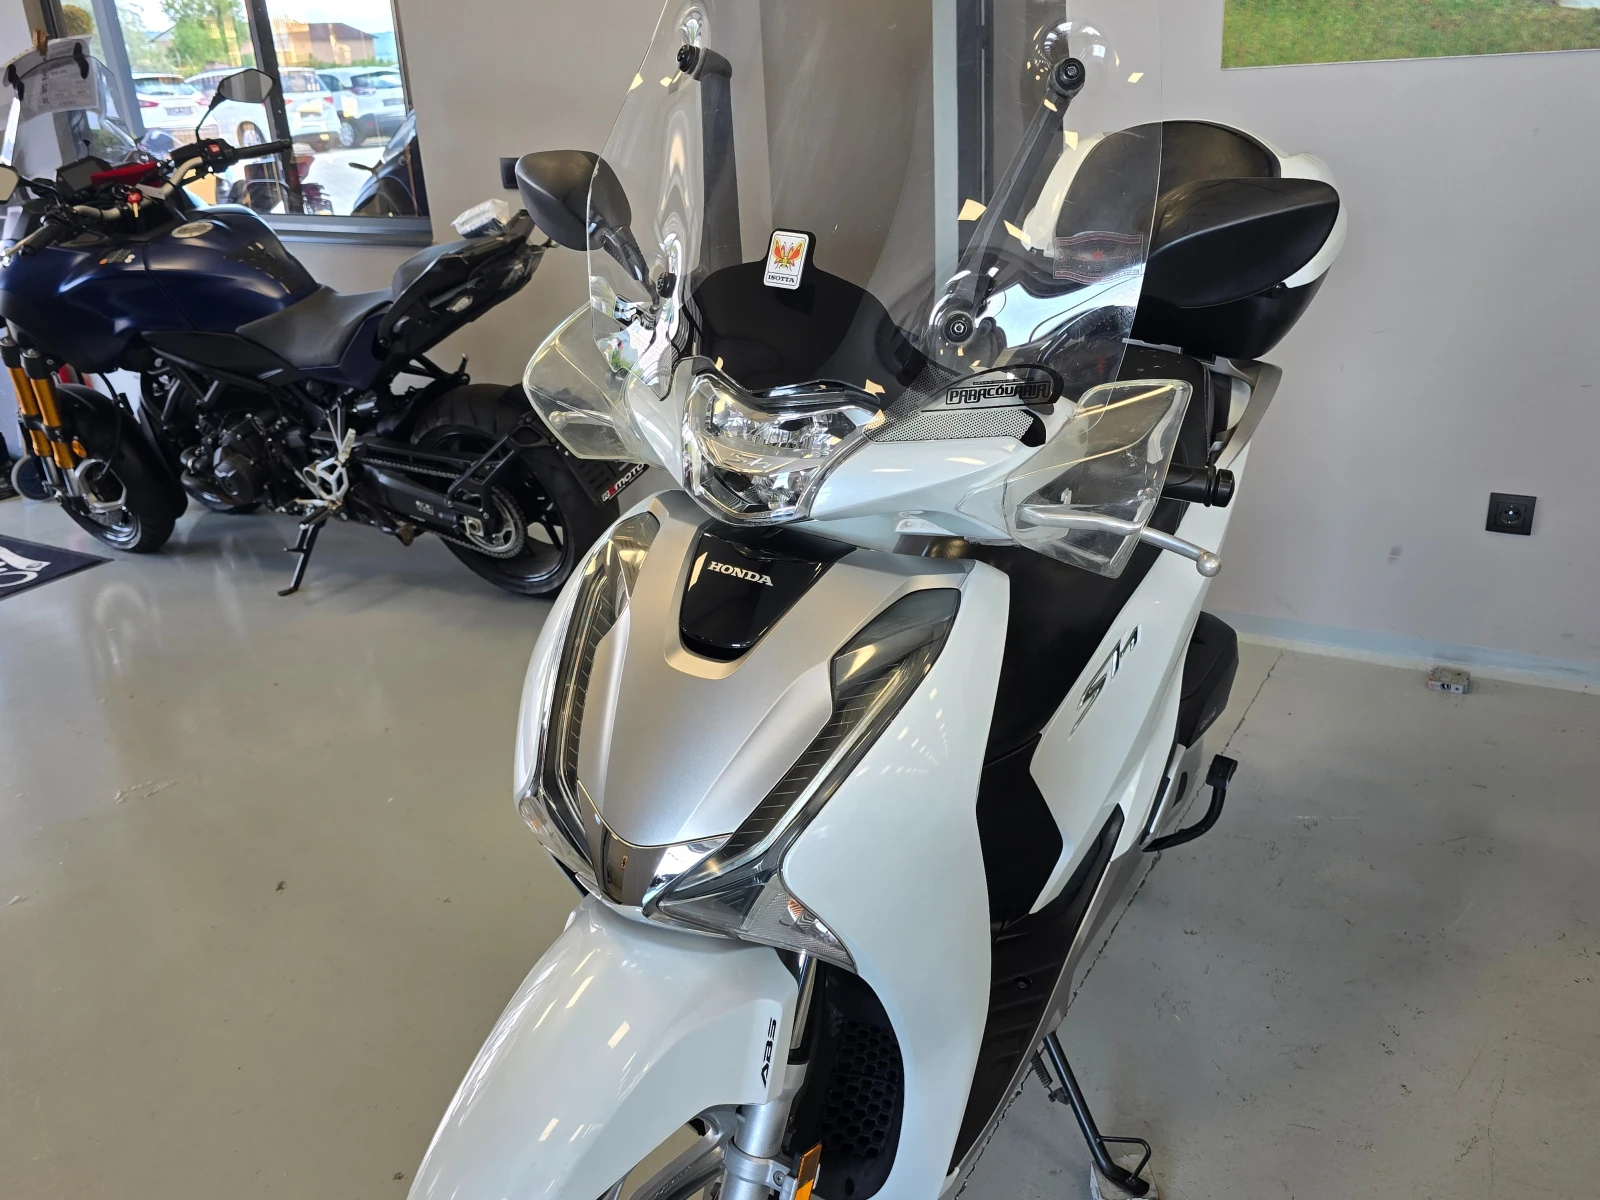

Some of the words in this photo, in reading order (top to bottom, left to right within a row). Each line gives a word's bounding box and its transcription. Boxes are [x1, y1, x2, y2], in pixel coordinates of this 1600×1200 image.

[767, 274, 795, 283] ISOTTA
[707, 561, 774, 587] HONDA
[761, 1017, 777, 1089] ABS
